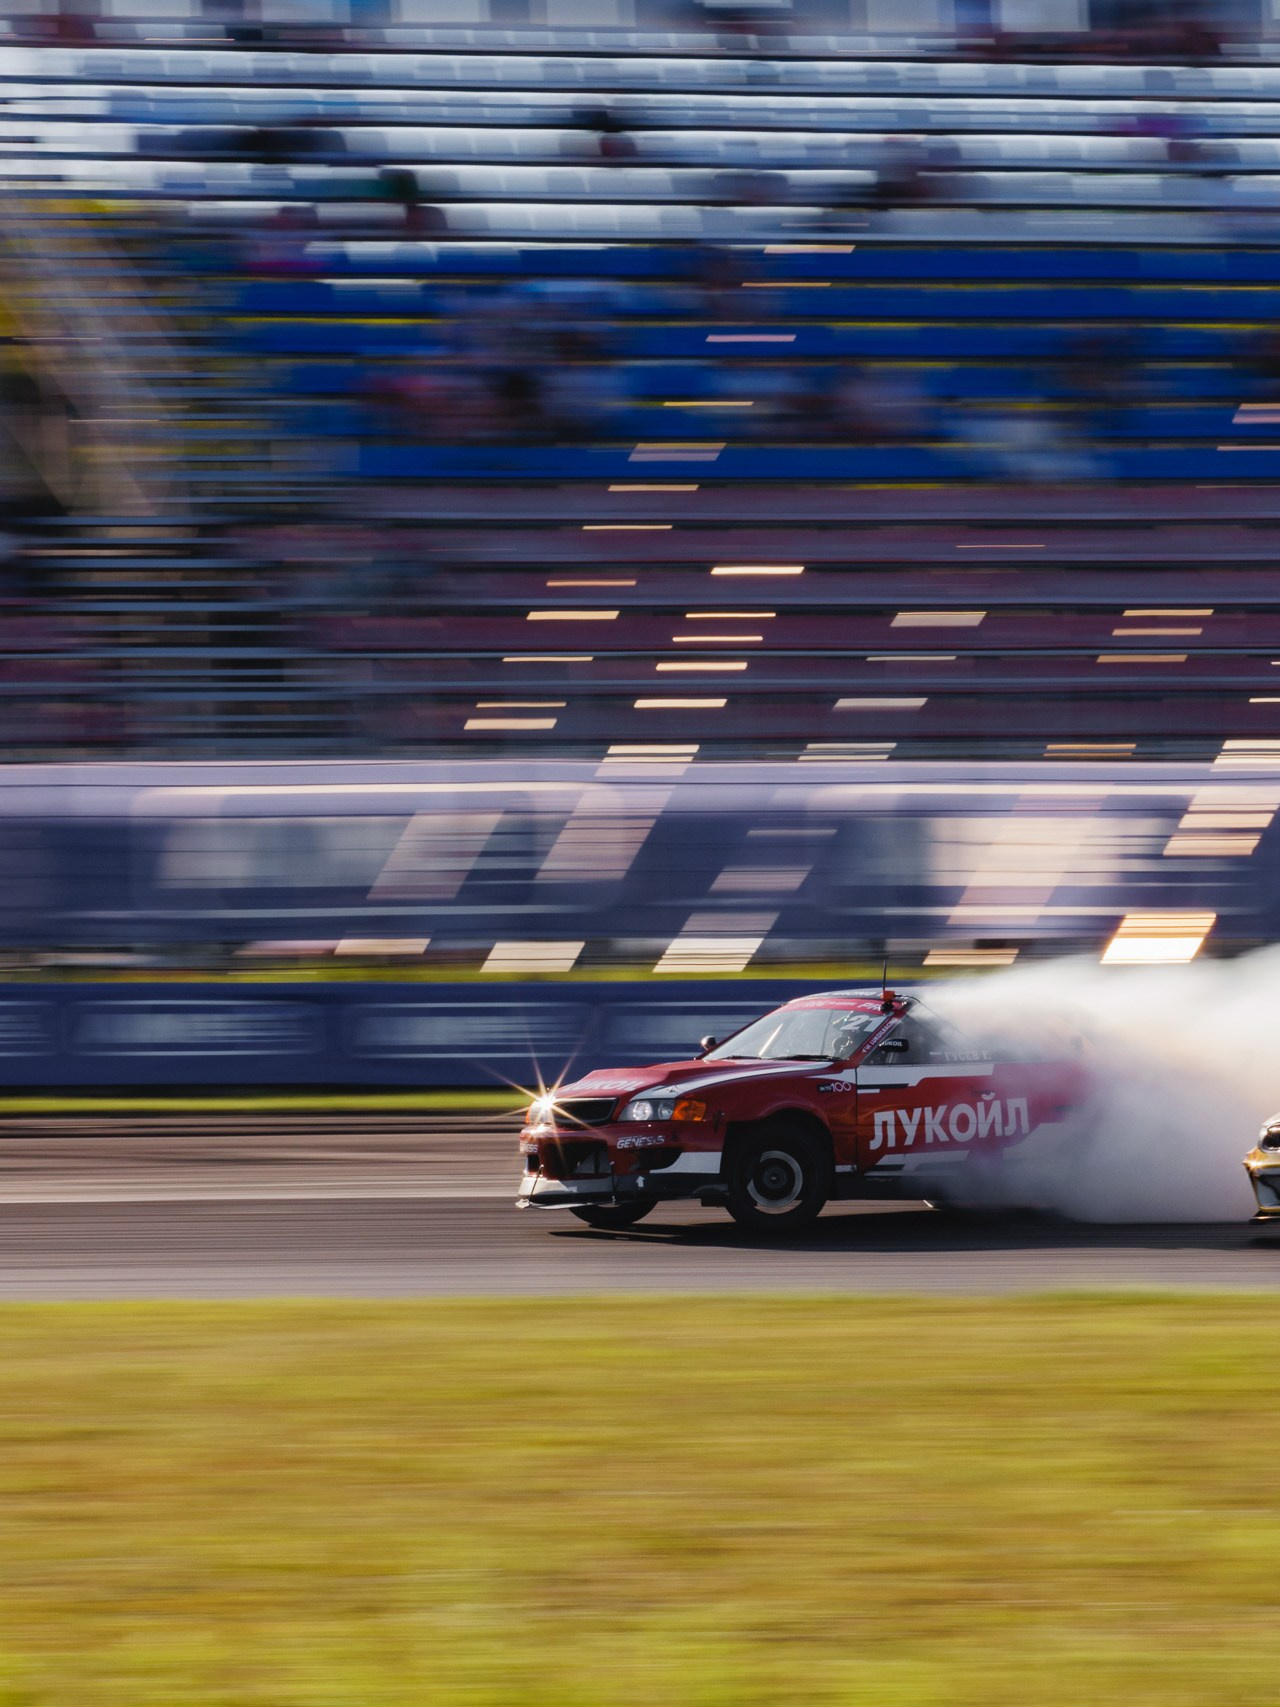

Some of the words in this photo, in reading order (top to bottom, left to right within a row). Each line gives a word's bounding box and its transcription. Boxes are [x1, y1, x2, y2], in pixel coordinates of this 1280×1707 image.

[840, 1015, 887, 1032] 21
[869, 1092, 1030, 1151] ЛУКОЙЛ
[616, 1135, 665, 1149] GENESIS
